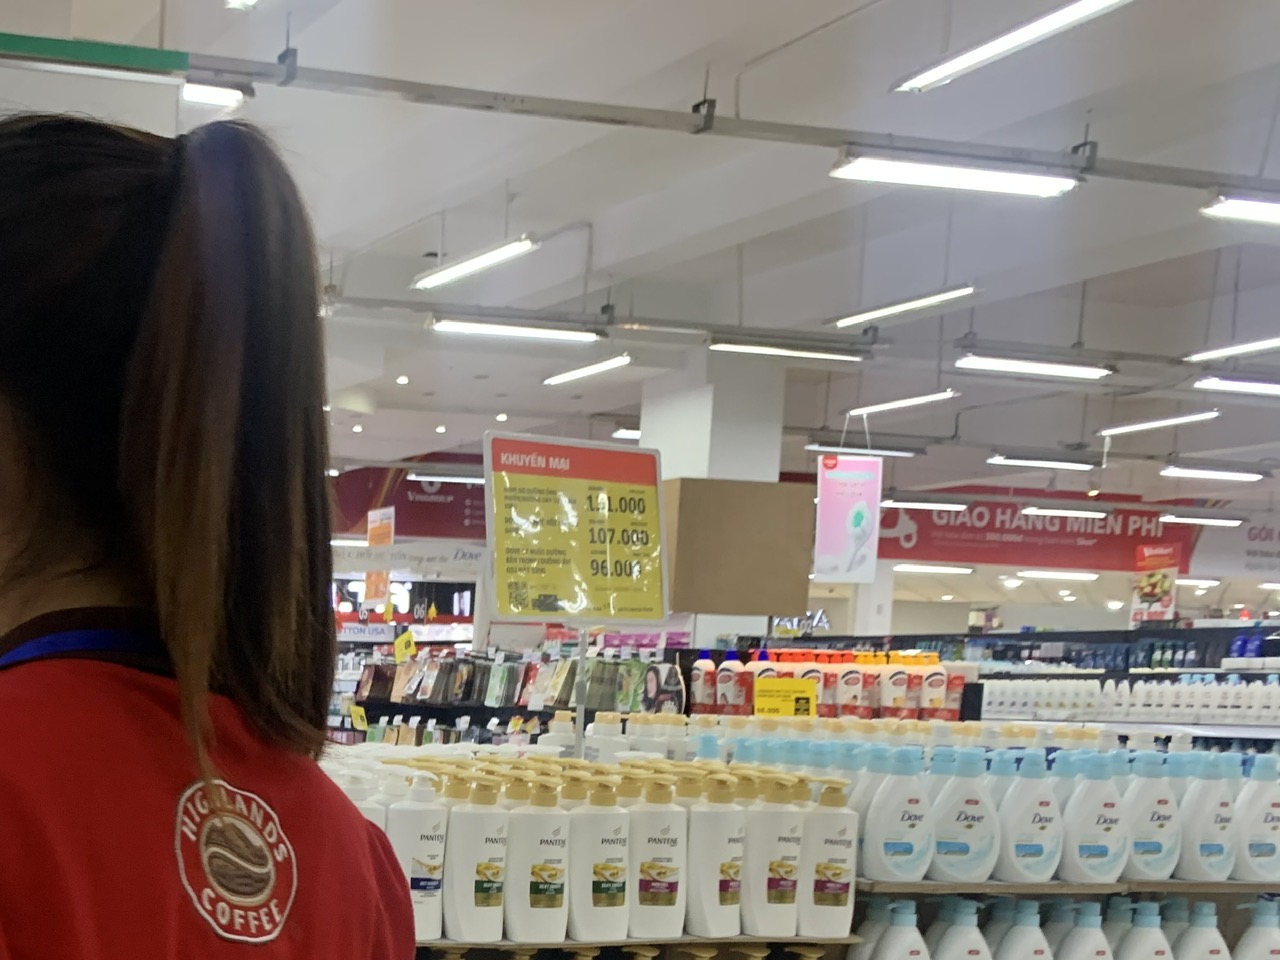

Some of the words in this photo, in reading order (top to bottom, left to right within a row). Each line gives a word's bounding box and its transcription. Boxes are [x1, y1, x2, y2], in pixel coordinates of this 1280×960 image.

[549, 458, 570, 472] MẠI
[589, 527, 650, 546] 107.000
[590, 559, 642, 577] 96.000
[901, 810, 924, 822] Dove
[955, 810, 985, 823] Dove
[1032, 813, 1055, 824] Dove
[1096, 814, 1119, 825] Dove
[1150, 811, 1172, 822] Dove
[181, 786, 289, 862] HIGLANDS
[647, 837, 679, 846] PANTENE
[201, 887, 283, 933] COFFEE
